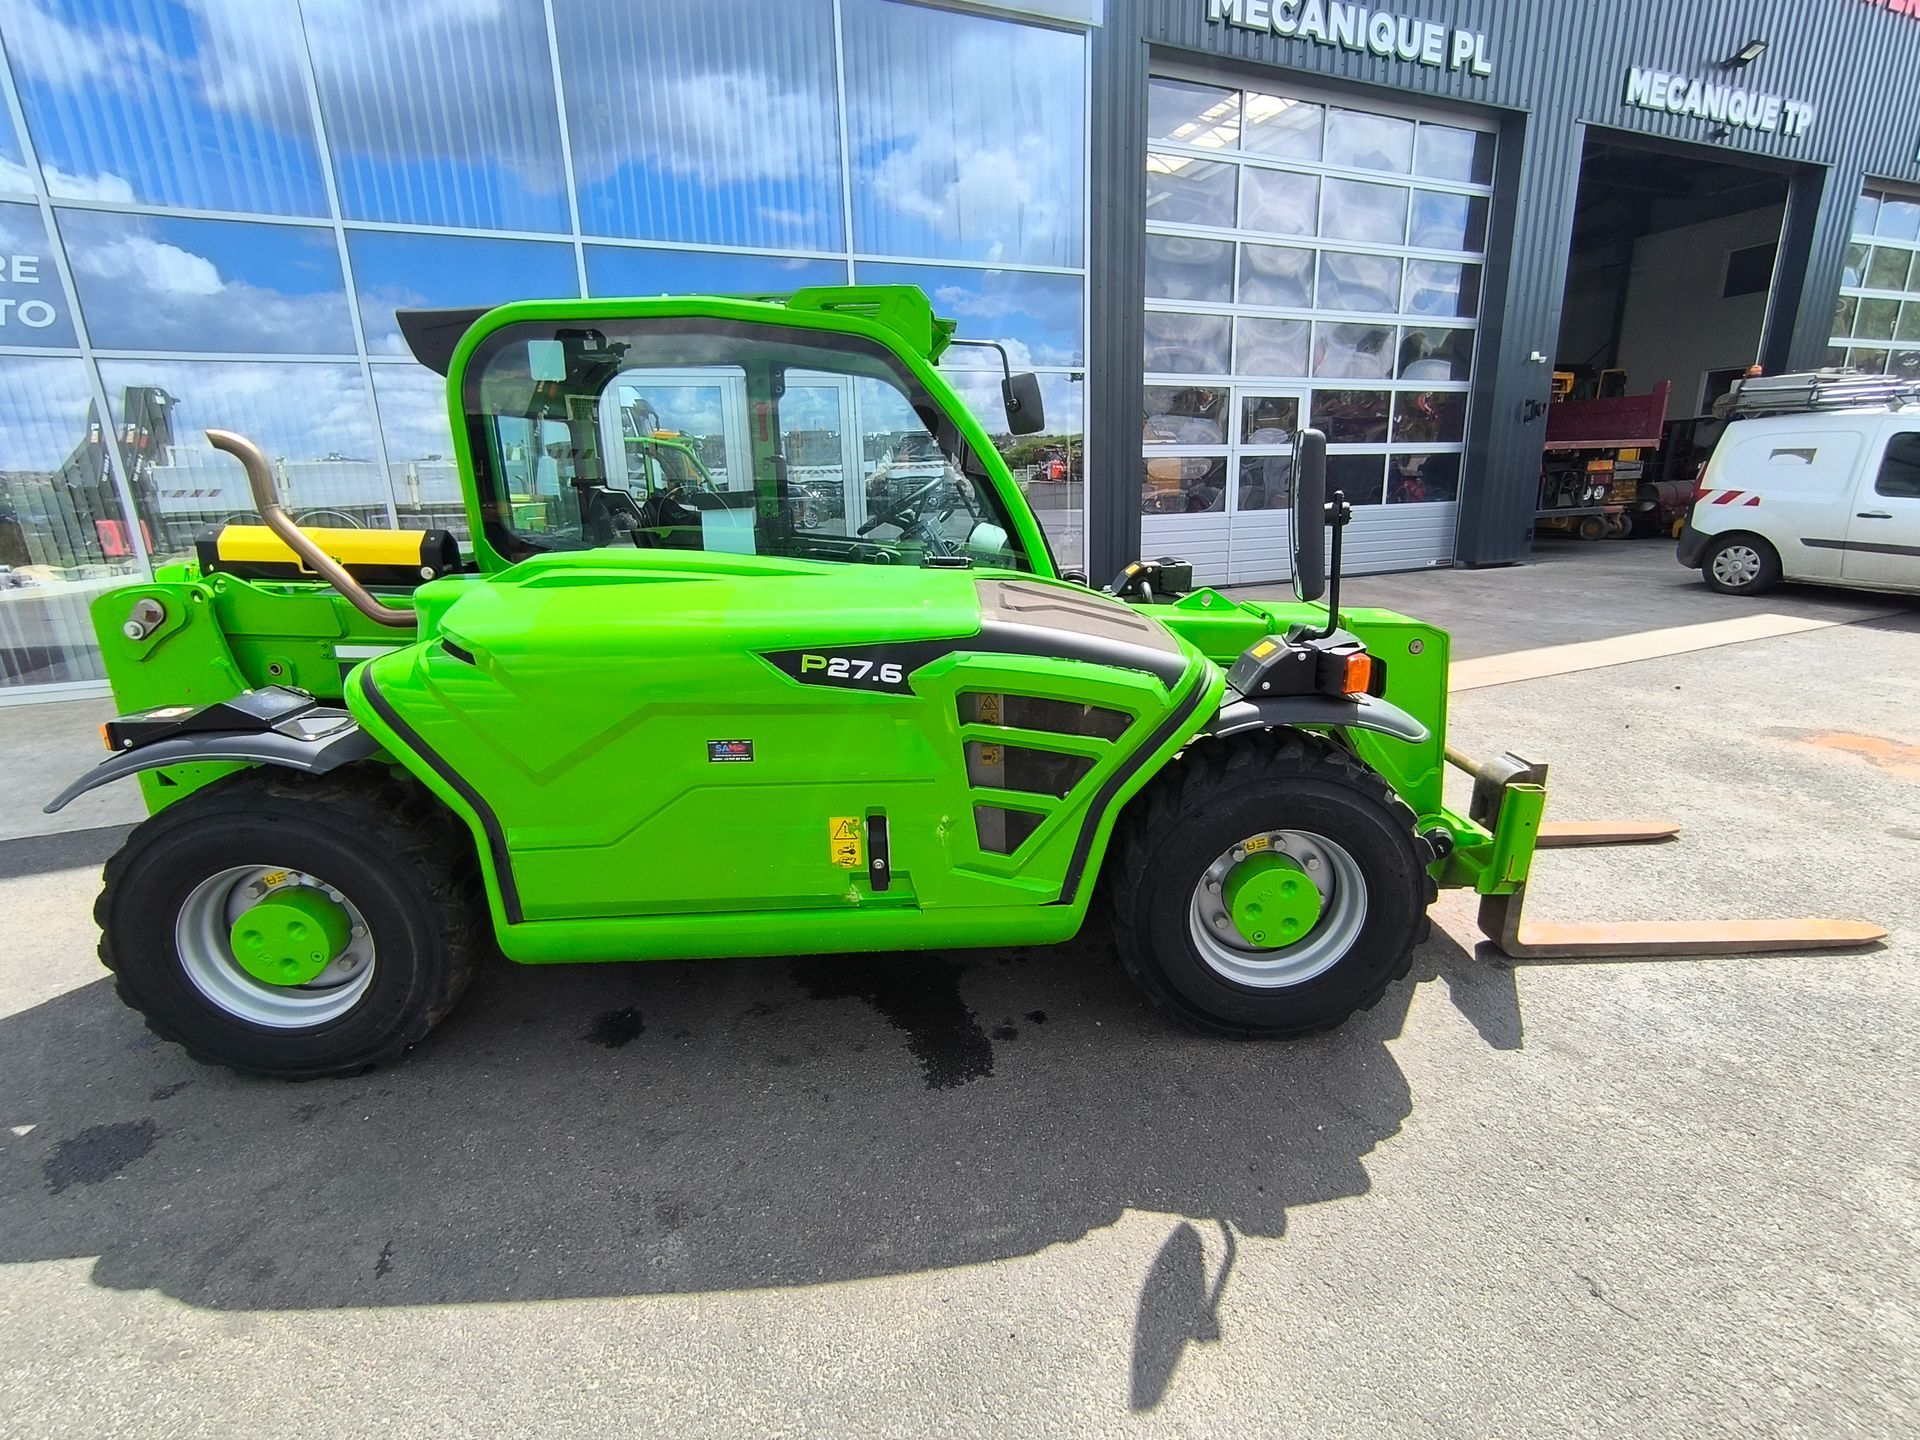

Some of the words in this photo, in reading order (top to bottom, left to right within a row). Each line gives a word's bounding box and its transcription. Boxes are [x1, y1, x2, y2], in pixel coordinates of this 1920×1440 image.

[1207, 0, 1445, 65] MECANIQUE
[1452, 29, 1492, 74] PL
[1625, 66, 1781, 131] MECANIQUE
[1783, 99, 1814, 137] TP
[801, 653, 903, 683] P27.6
